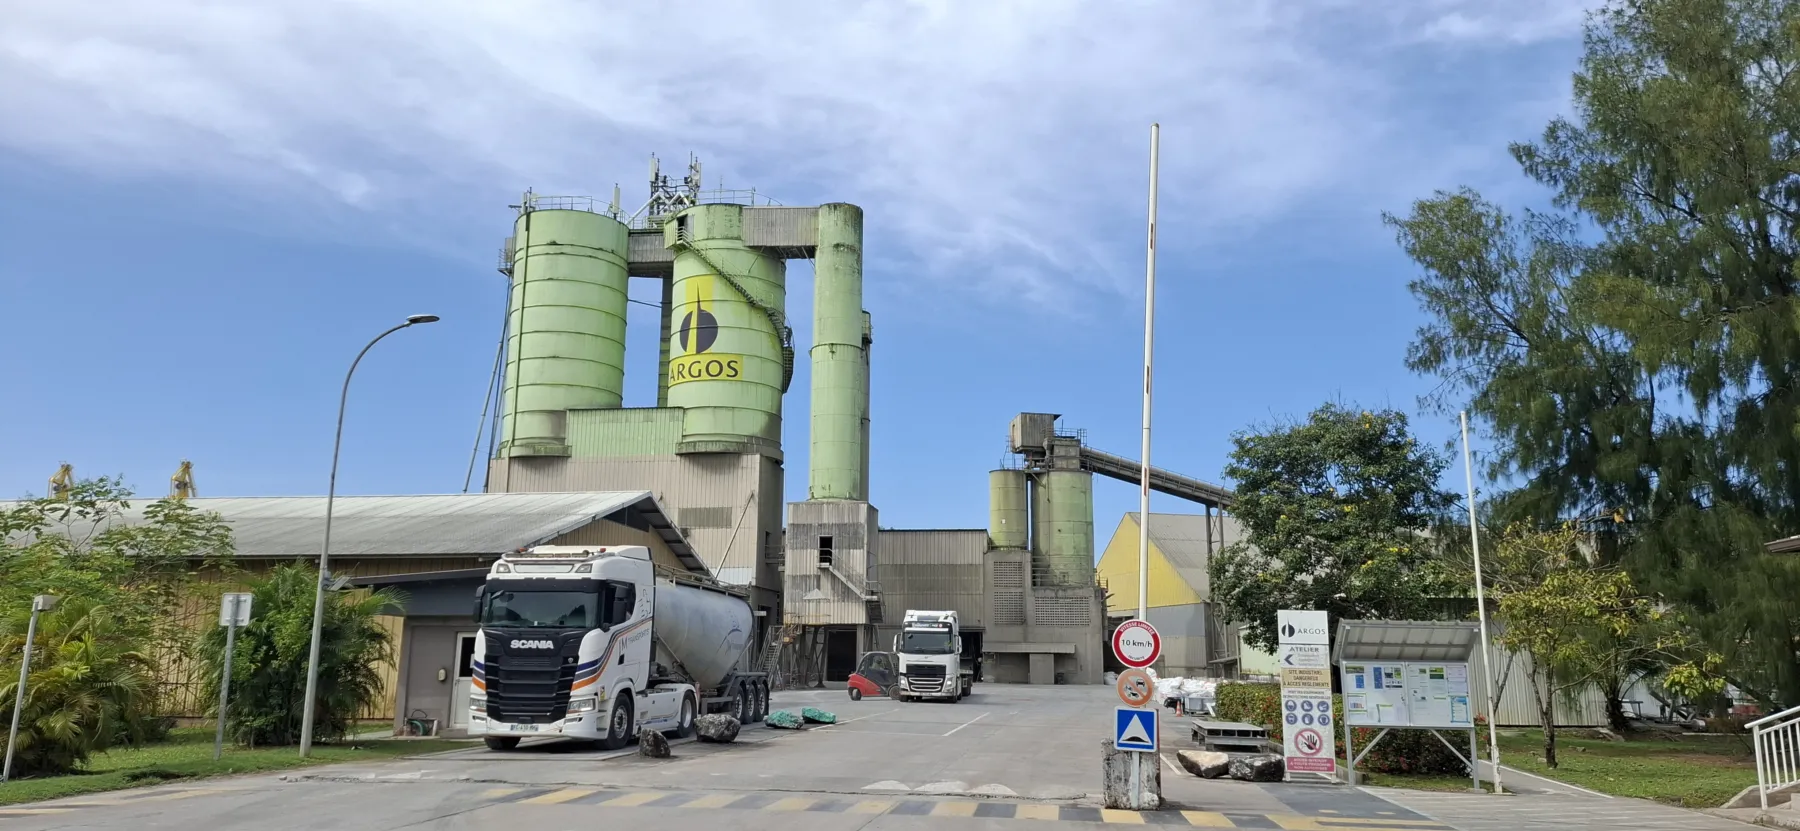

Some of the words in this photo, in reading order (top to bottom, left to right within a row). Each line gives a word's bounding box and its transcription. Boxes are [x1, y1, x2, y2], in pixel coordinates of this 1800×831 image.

[670, 359, 739, 382] ARGOS
[510, 639, 554, 649] SCANIA
[1132, 639, 1153, 648] km/h
